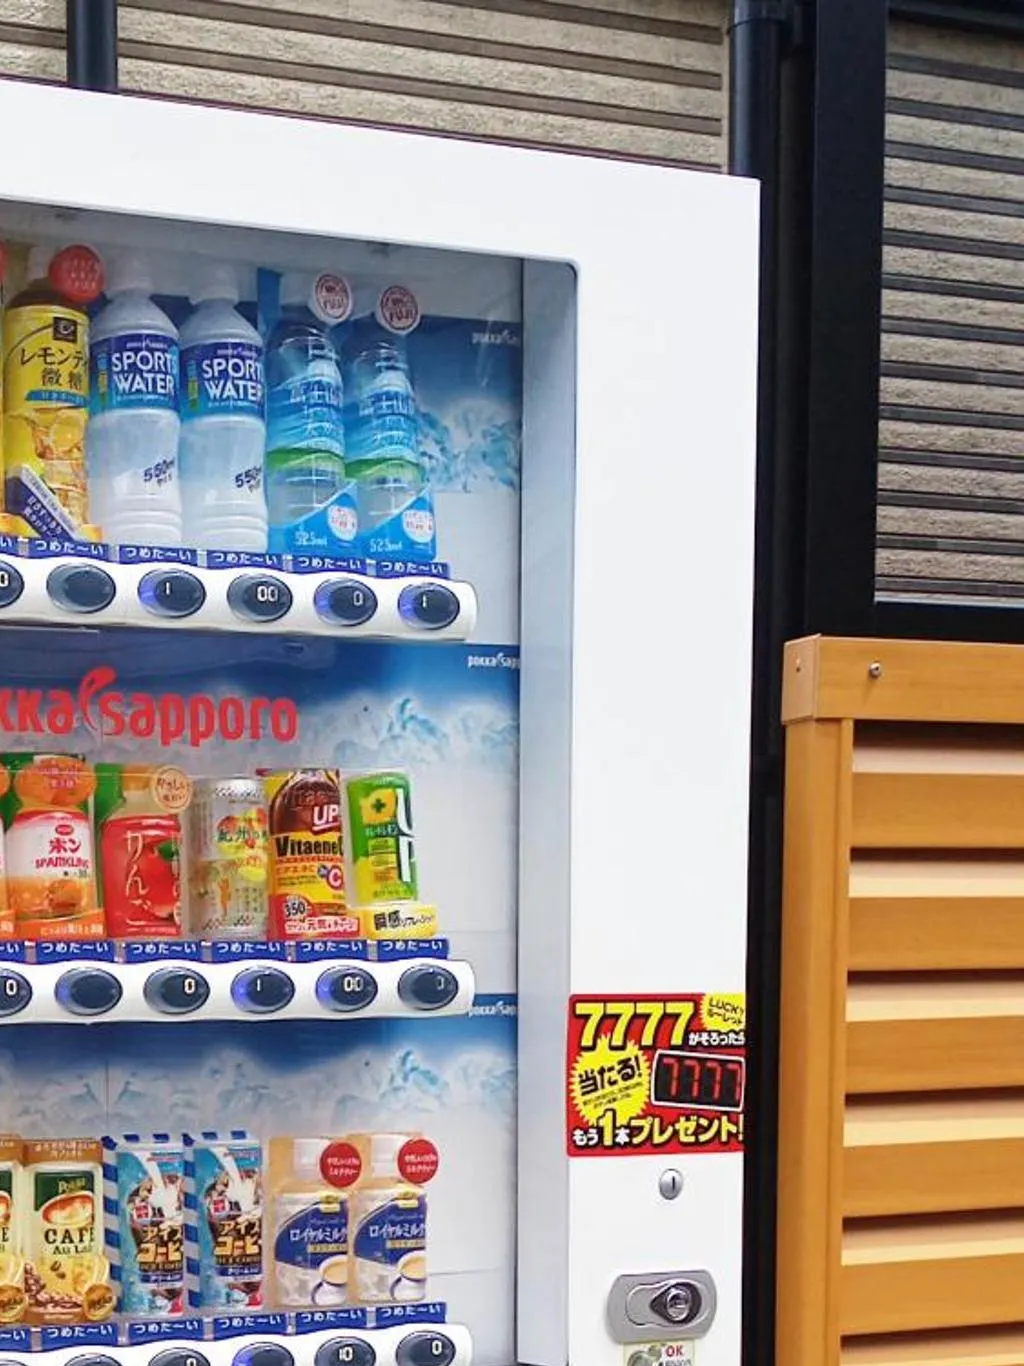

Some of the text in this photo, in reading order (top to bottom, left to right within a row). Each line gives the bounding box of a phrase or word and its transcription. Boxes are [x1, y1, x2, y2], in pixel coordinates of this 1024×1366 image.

[111, 350, 174, 372] SPORT
[313, 804, 339, 826] UP
[575, 1001, 695, 1047] 7777
[665, 1344, 684, 1357] OK
